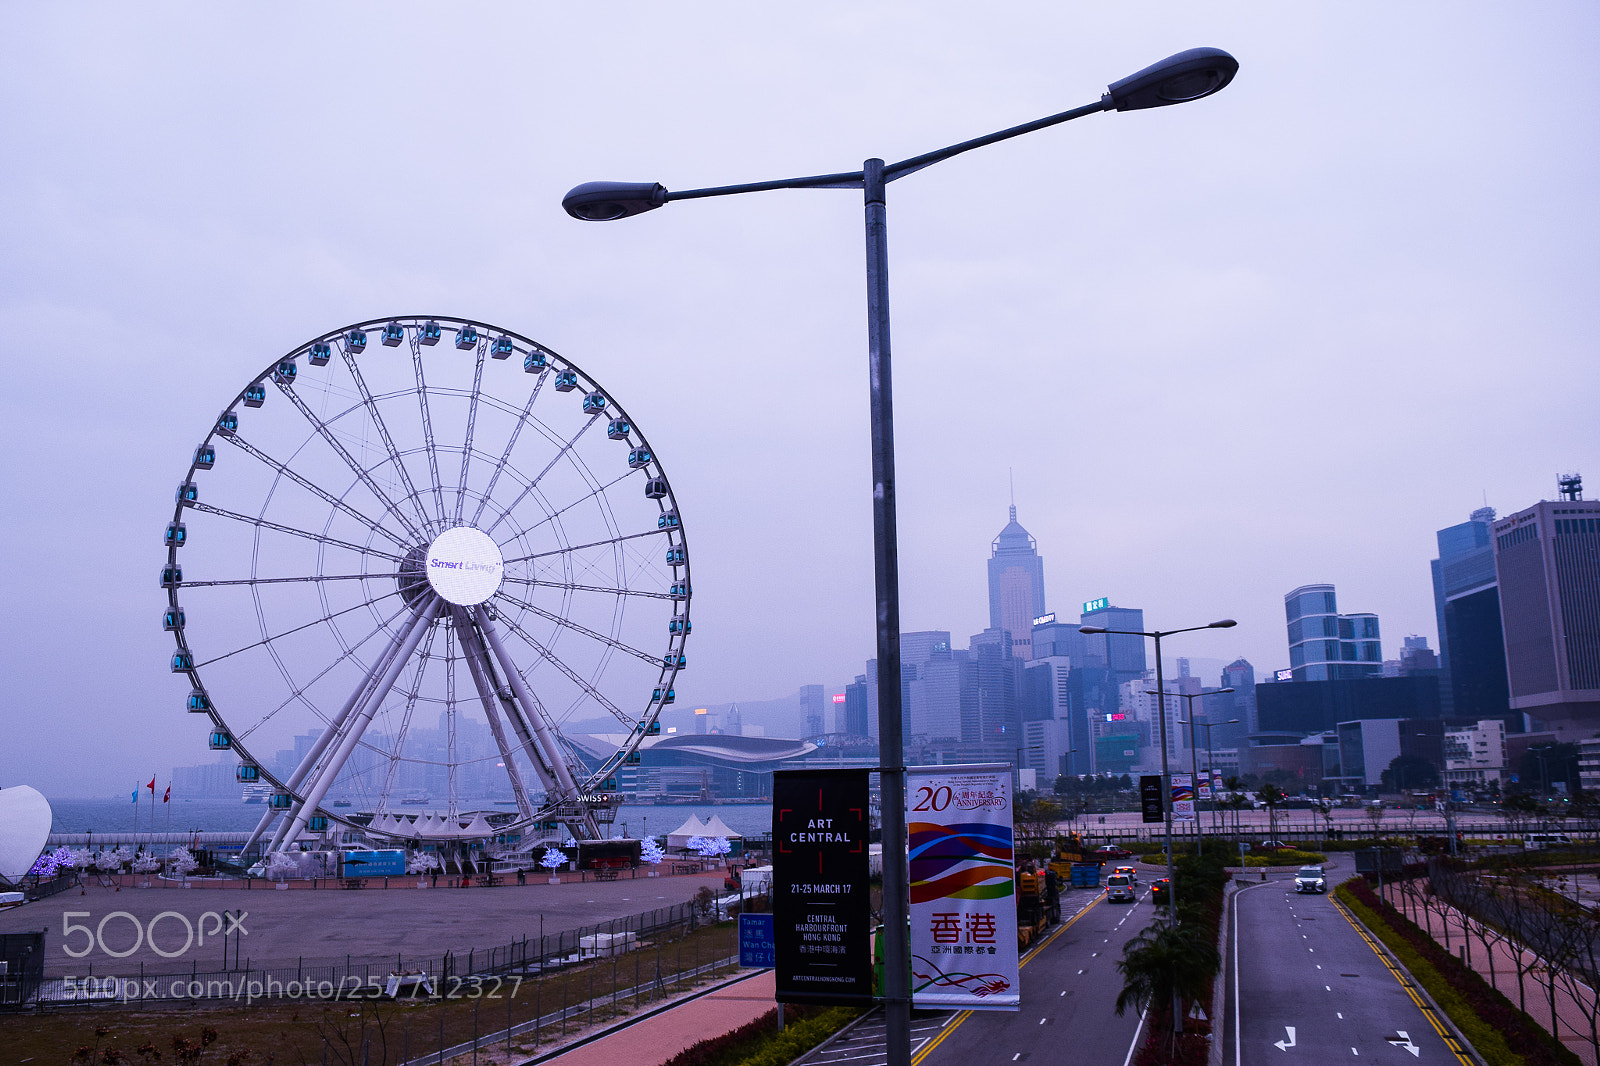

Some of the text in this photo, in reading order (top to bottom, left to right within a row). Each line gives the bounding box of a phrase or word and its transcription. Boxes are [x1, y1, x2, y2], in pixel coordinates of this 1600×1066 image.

[430, 558, 463, 570] Smart
[576, 794, 602, 803] SWISS
[807, 818, 833, 829] ART
[790, 832, 851, 843] CENTRAL
[791, 883, 852, 894] 21-25 MARCH 17
[742, 918, 766, 926] Tamar
[807, 914, 836, 924] CENTRAL
[795, 923, 848, 933] HARBOURFRONT
[929, 912, 997, 944] 香港
[803, 933, 841, 942] HONG KONG
[742, 940, 760, 949] Wan
[930, 945, 997, 955] 亞洲國際都會
